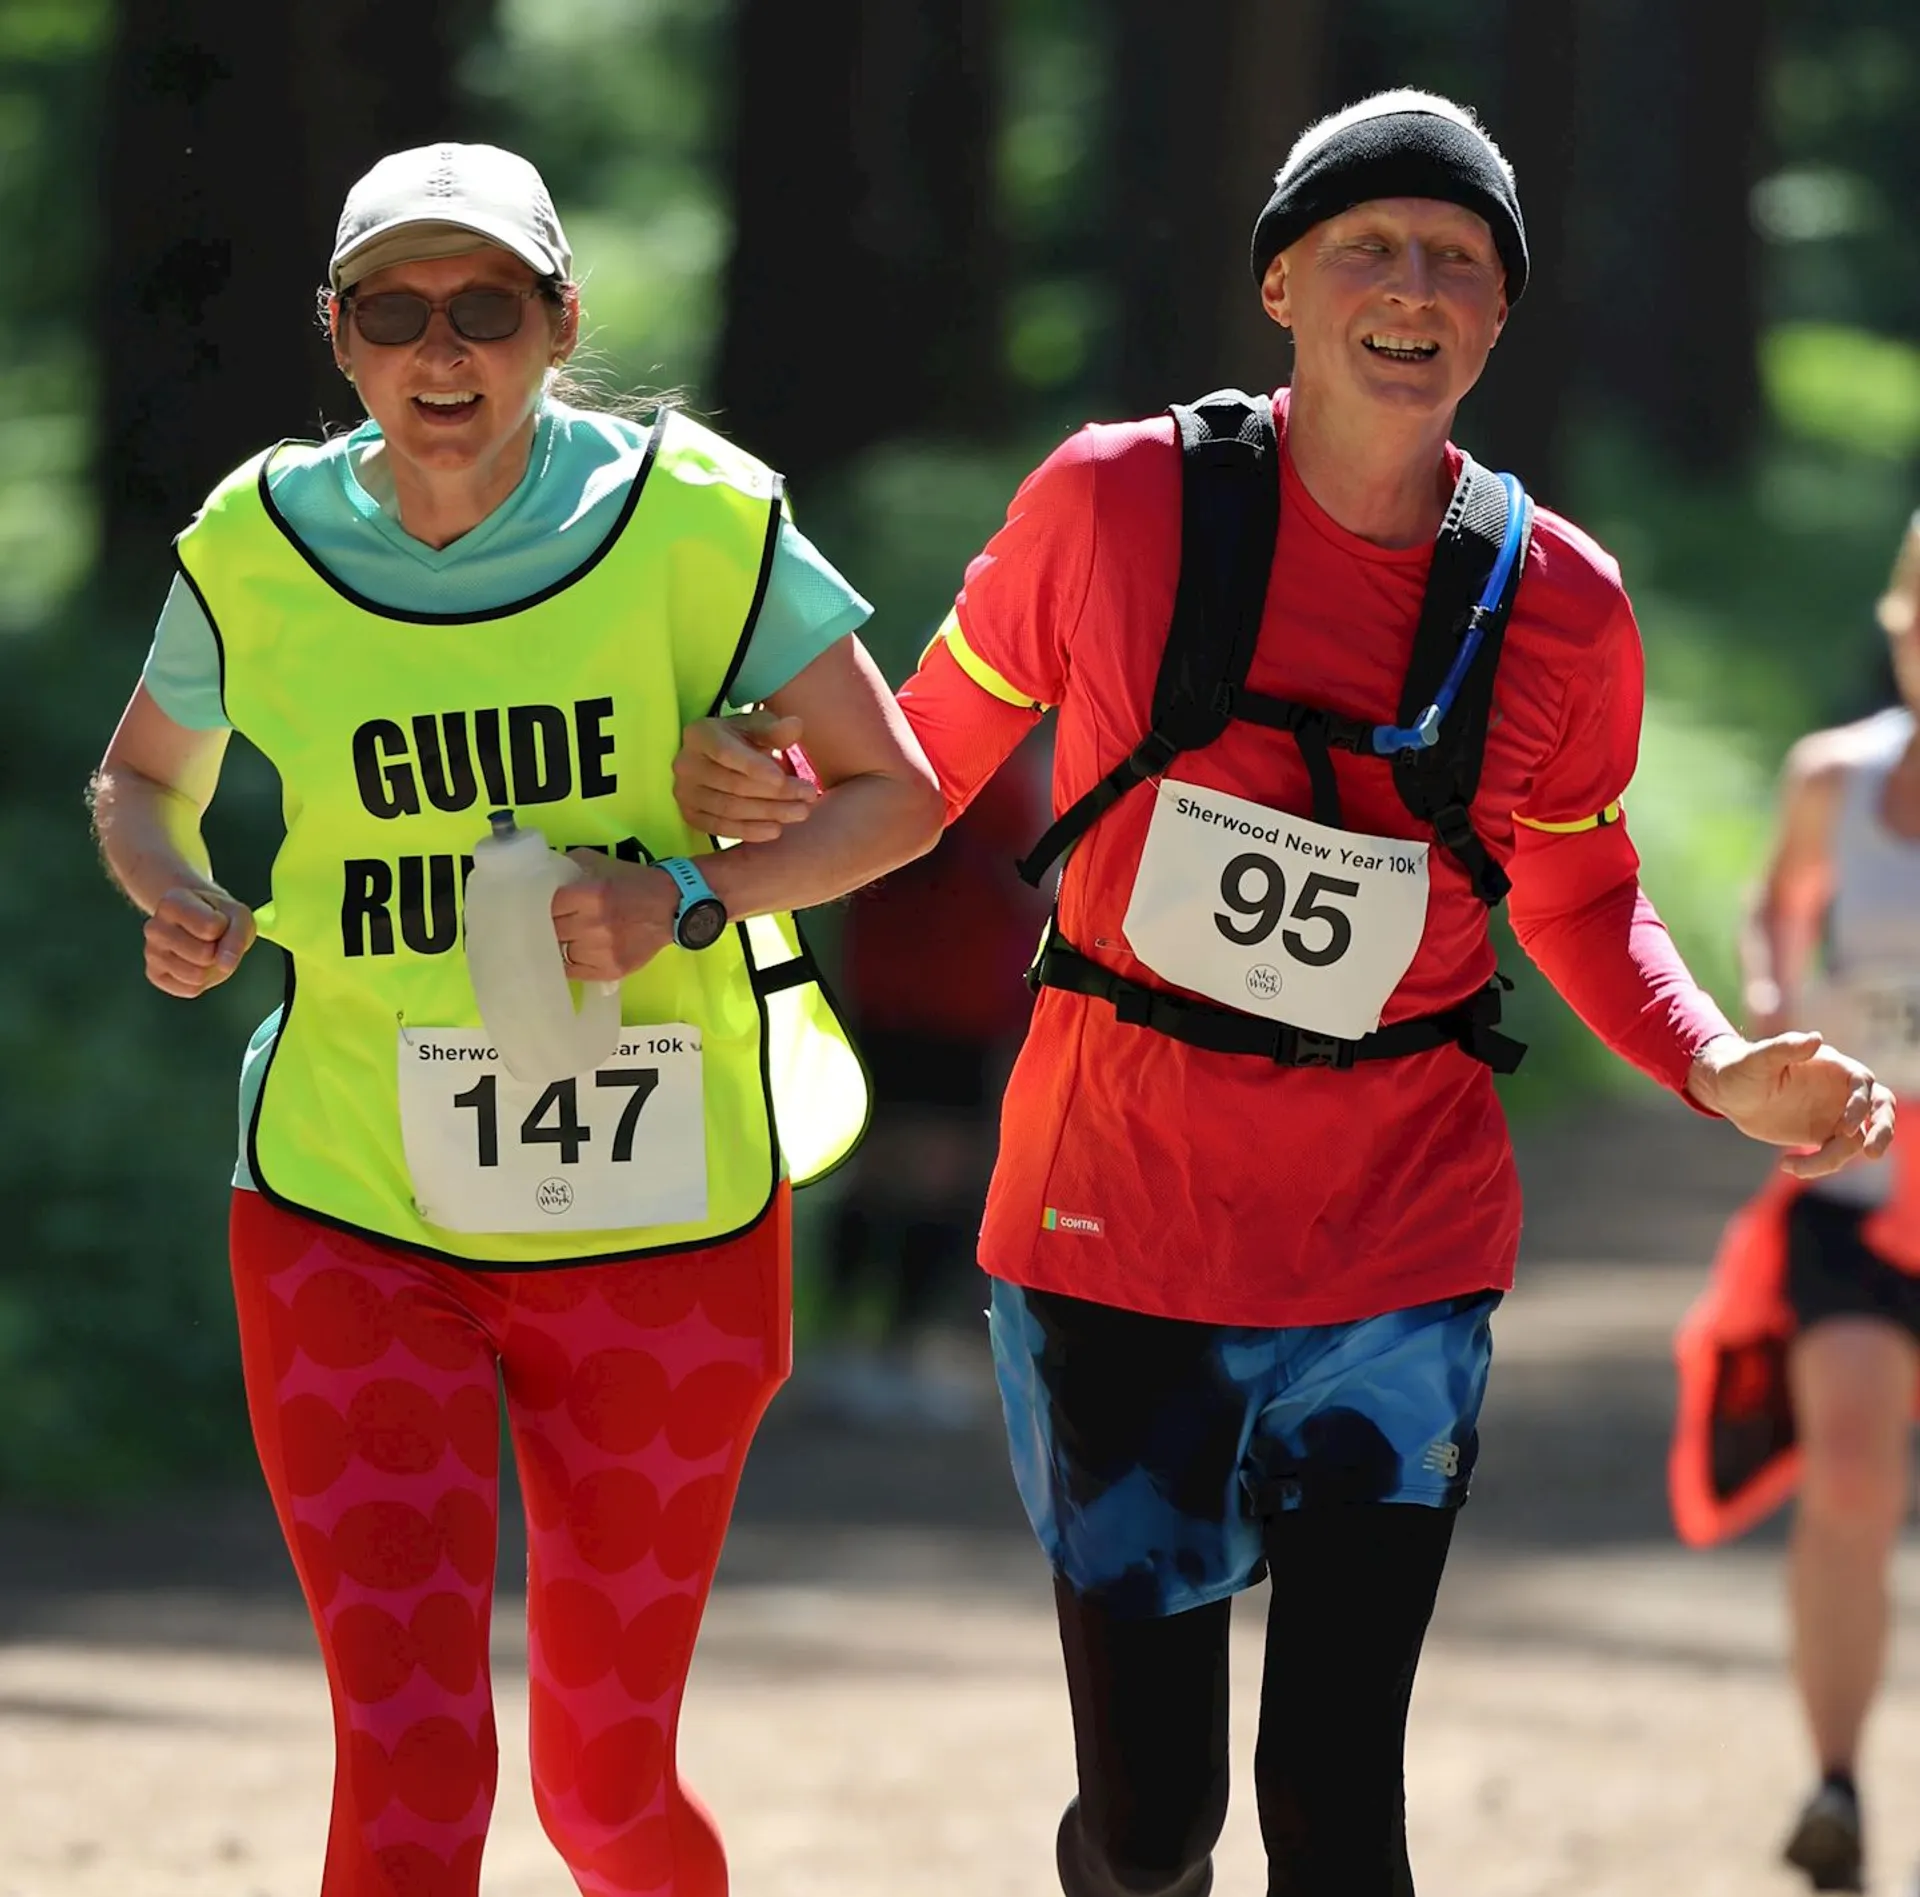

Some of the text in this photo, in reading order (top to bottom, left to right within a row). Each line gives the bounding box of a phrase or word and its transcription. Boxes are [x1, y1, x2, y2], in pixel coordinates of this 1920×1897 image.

[353, 696, 617, 820] GUIDE
[1176, 798, 1416, 875] Sherwood New Year 10k
[1213, 852, 1360, 967] 95
[1249, 978, 1279, 993] Work
[1253, 968, 1279, 984] Nice
[418, 1044, 499, 1060] Sherwo
[647, 1037, 684, 1054] 10k
[454, 1068, 659, 1167] 147
[540, 1191, 570, 1206] Work
[542, 1182, 568, 1196] Nice
[1060, 1216, 1100, 1233] CONTRA
